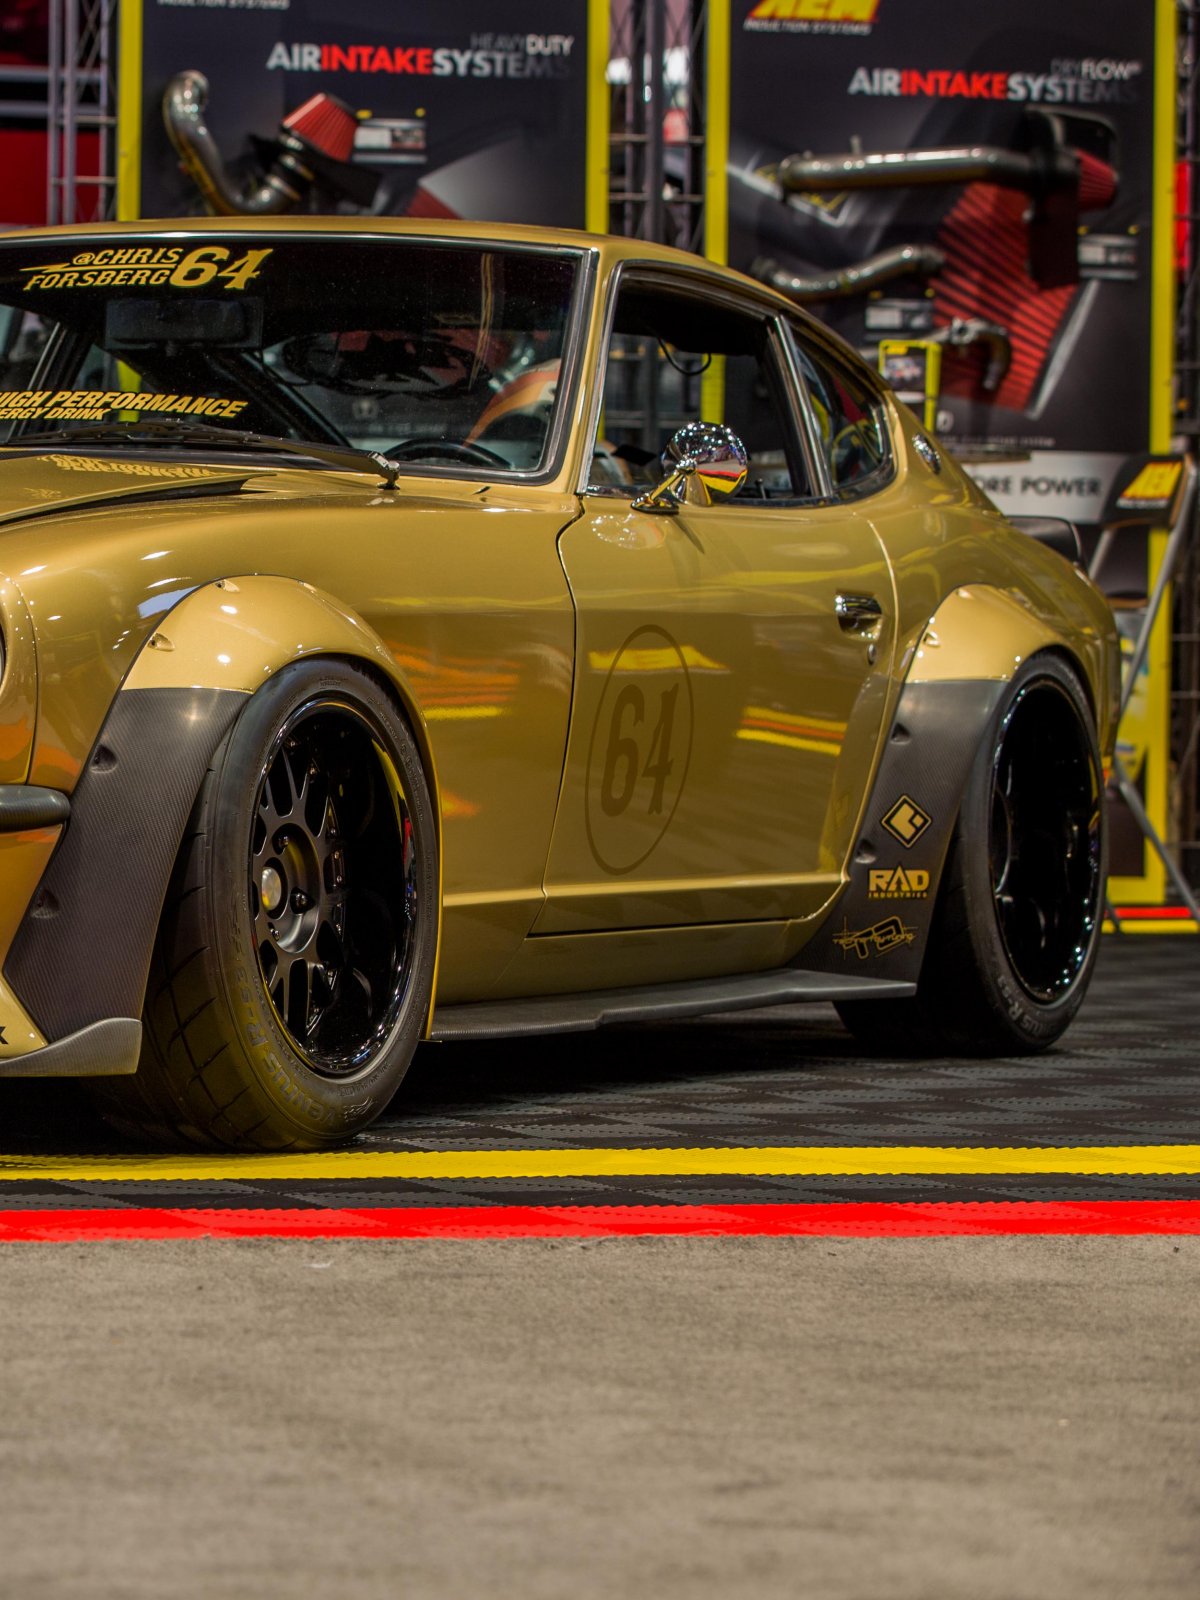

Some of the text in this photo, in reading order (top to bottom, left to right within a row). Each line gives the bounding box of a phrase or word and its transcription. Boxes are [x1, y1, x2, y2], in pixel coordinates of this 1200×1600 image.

[72, 247, 184, 266] @CHRIS
[169, 246, 274, 291] 64
[22, 269, 171, 291] FORSBERG
[47, 407, 113, 421] DRINK
[52, 390, 248, 419] PERFORMANCE
[1020, 475, 1103, 497] POWER
[600, 683, 680, 818] 64
[868, 864, 931, 892] RAD
